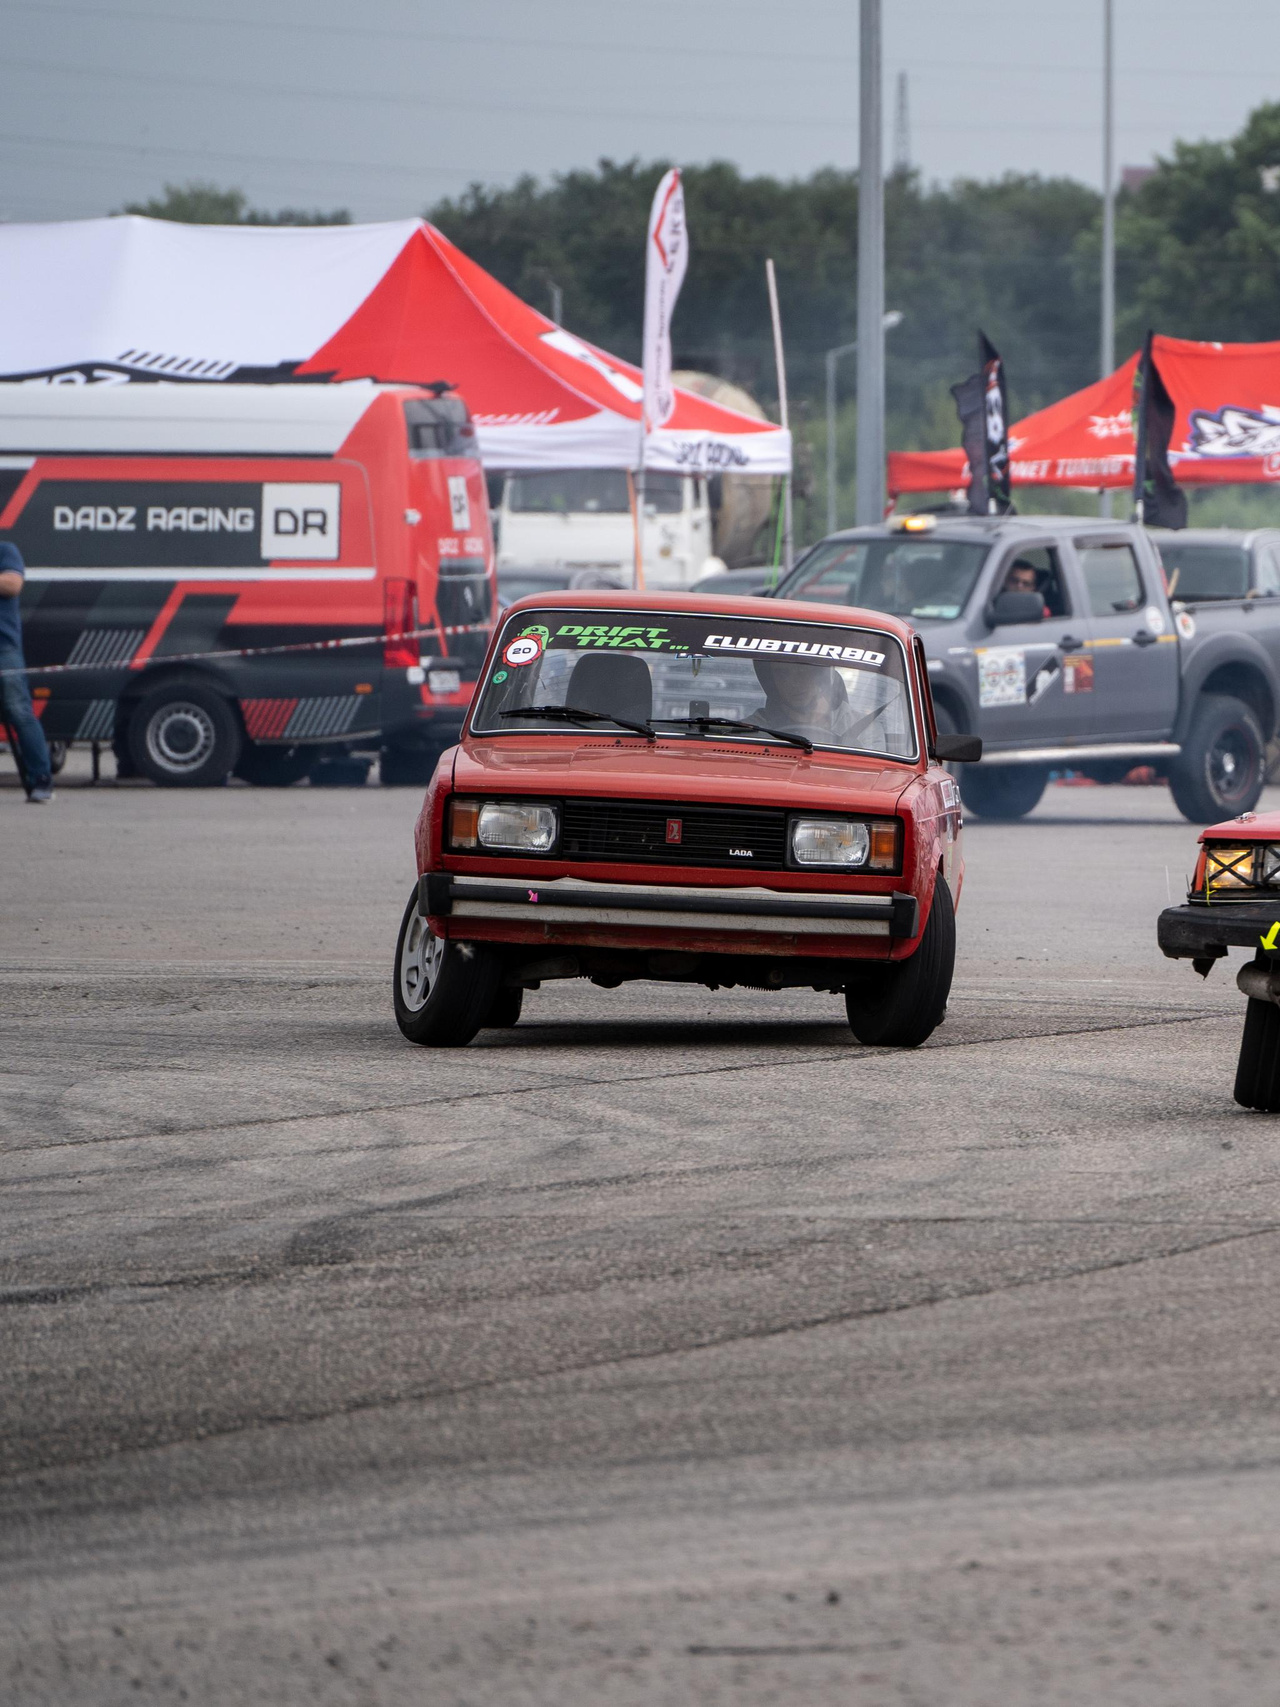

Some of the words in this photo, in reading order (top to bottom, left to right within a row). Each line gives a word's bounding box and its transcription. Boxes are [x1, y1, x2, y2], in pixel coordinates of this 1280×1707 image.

[53, 506, 136, 531] DADZ
[146, 506, 254, 532] RACING
[273, 508, 327, 535] DR
[556, 625, 668, 638] DRIFT
[512, 647, 532, 655] 20
[703, 635, 886, 664] CLUBTURBO
[729, 849, 753, 857] LADA
